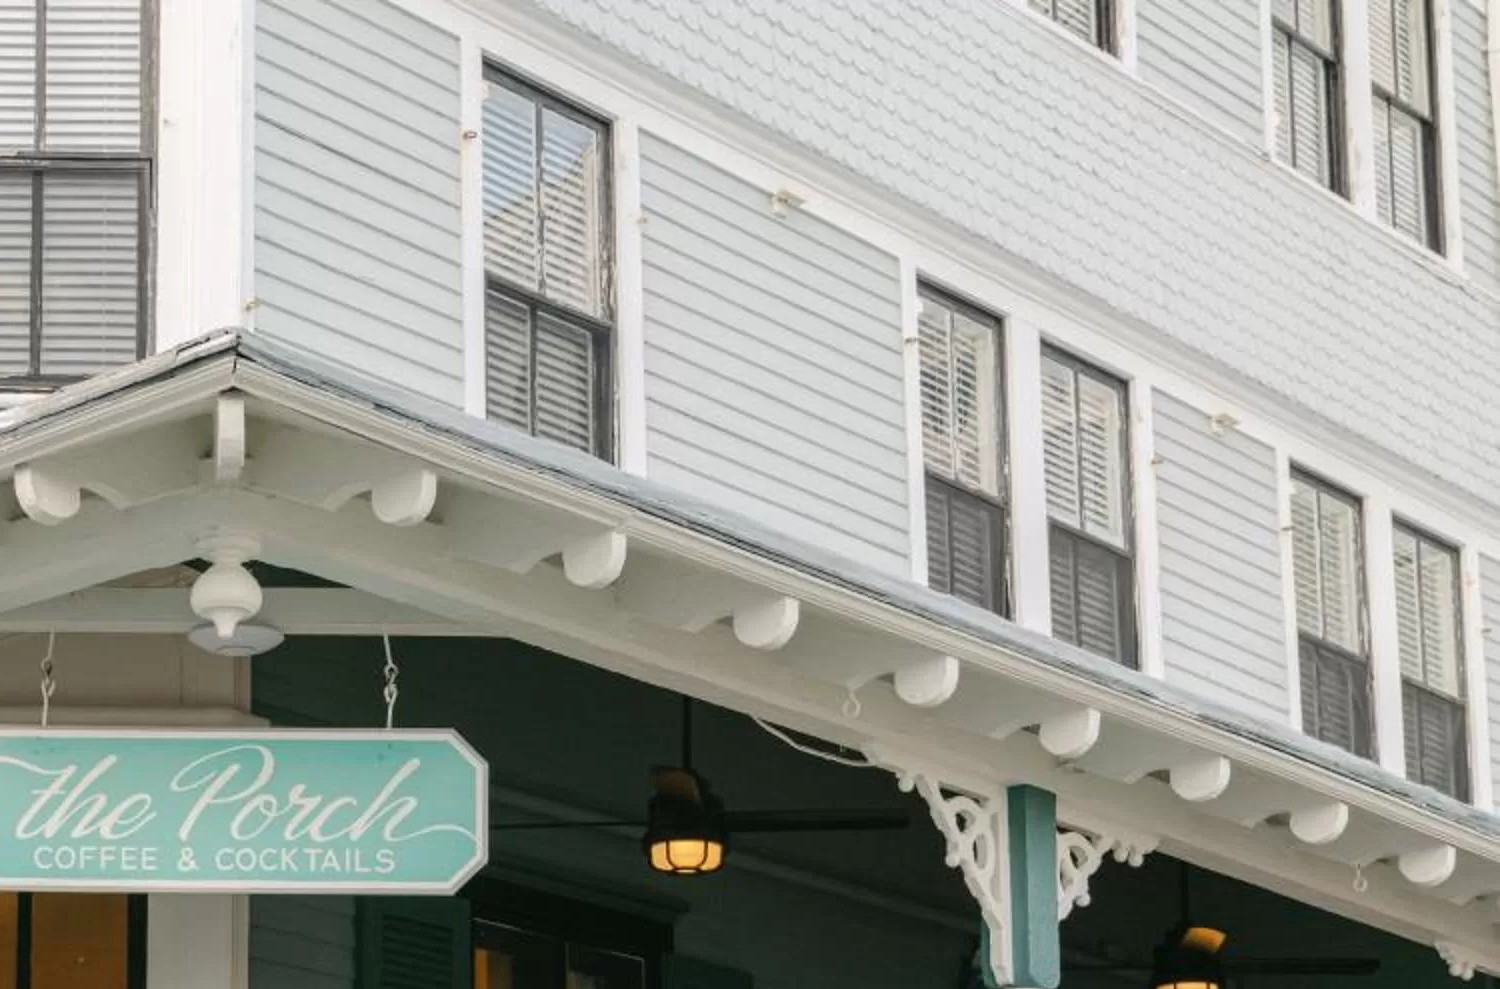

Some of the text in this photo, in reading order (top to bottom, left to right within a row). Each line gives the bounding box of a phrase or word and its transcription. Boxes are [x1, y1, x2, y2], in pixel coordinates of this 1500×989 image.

[169, 744, 480, 843] Porch
[33, 846, 396, 874] COFFEE & COCKTAILS
